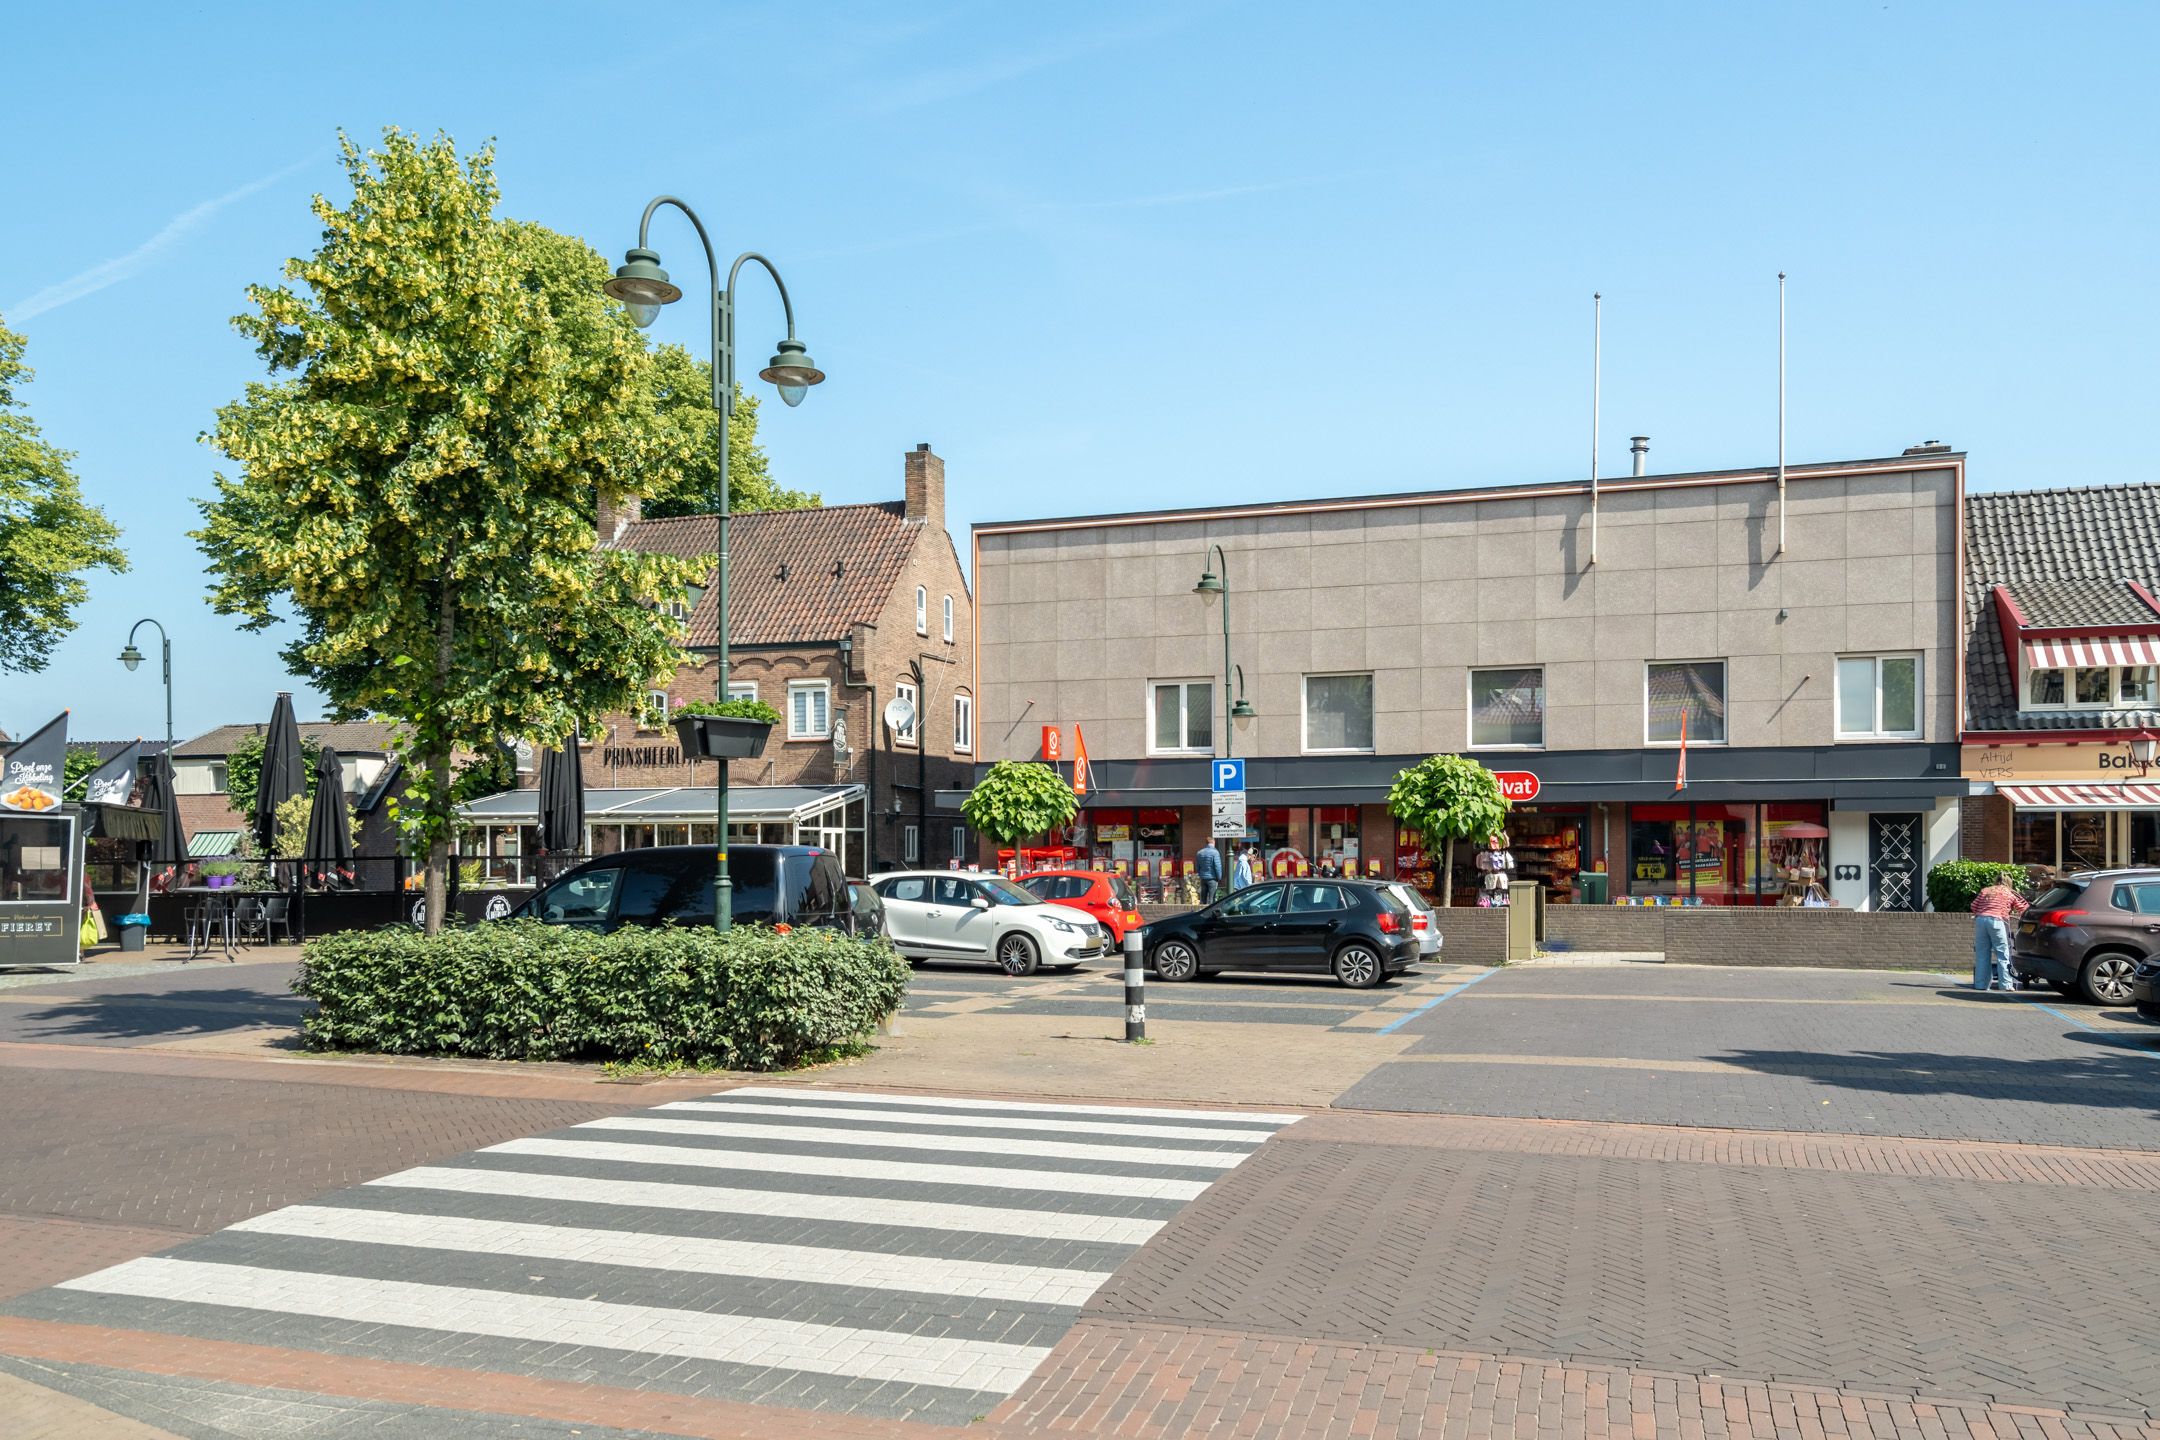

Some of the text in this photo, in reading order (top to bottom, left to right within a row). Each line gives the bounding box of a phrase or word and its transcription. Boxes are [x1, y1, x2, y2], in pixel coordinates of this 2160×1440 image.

[604, 746, 702, 766] PRINSHEERL
[1980, 750, 2013, 764] Altijd
[1219, 764, 1237, 788] P
[1979, 768, 2014, 778] VERS
[1, 922, 52, 932] FIERET
